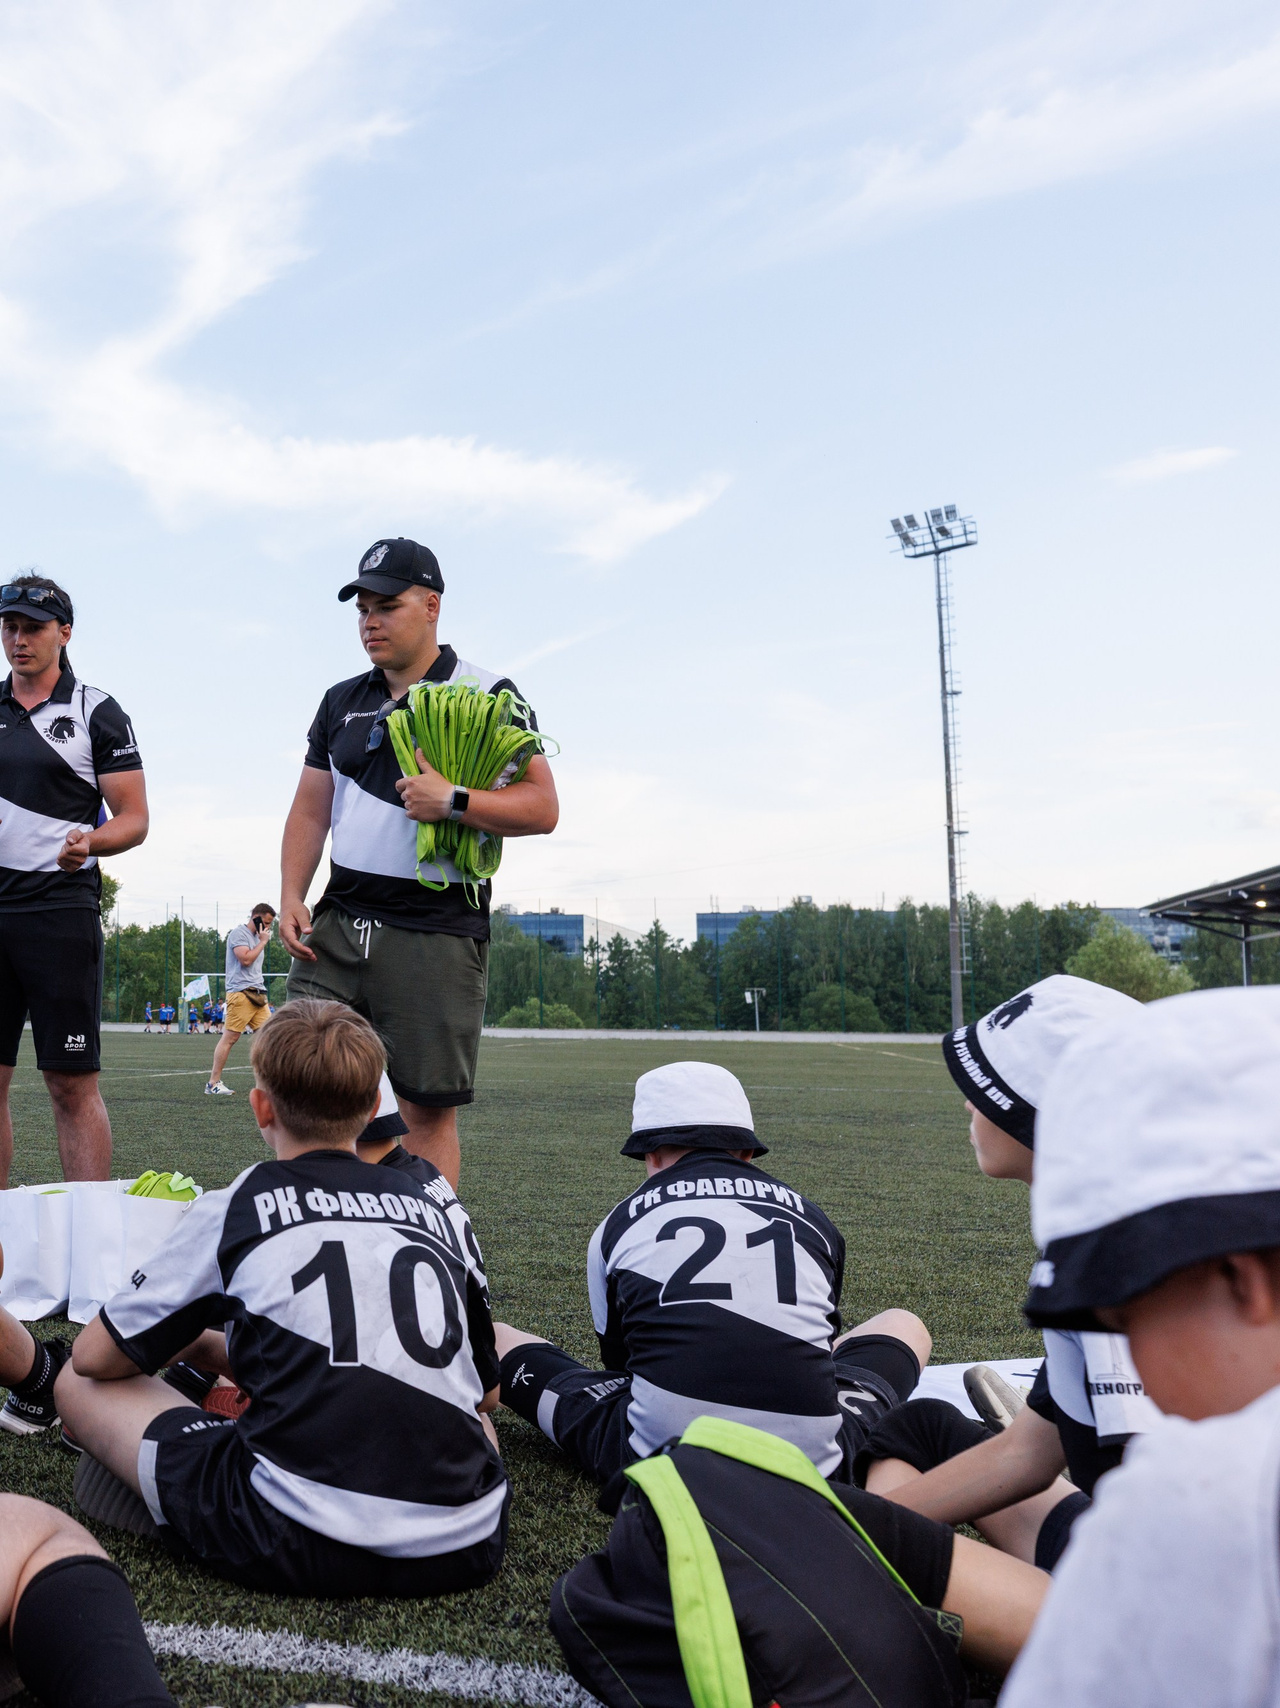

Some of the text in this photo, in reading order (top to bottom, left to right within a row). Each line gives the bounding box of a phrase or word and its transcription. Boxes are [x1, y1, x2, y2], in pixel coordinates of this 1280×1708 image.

[253, 1185, 304, 1235] РК
[304, 1187, 453, 1248] ФАВОРИТ
[628, 1176, 805, 1220] РК ФАВОРИТ
[655, 1215, 798, 1306] 21
[291, 1239, 464, 1369] 10
